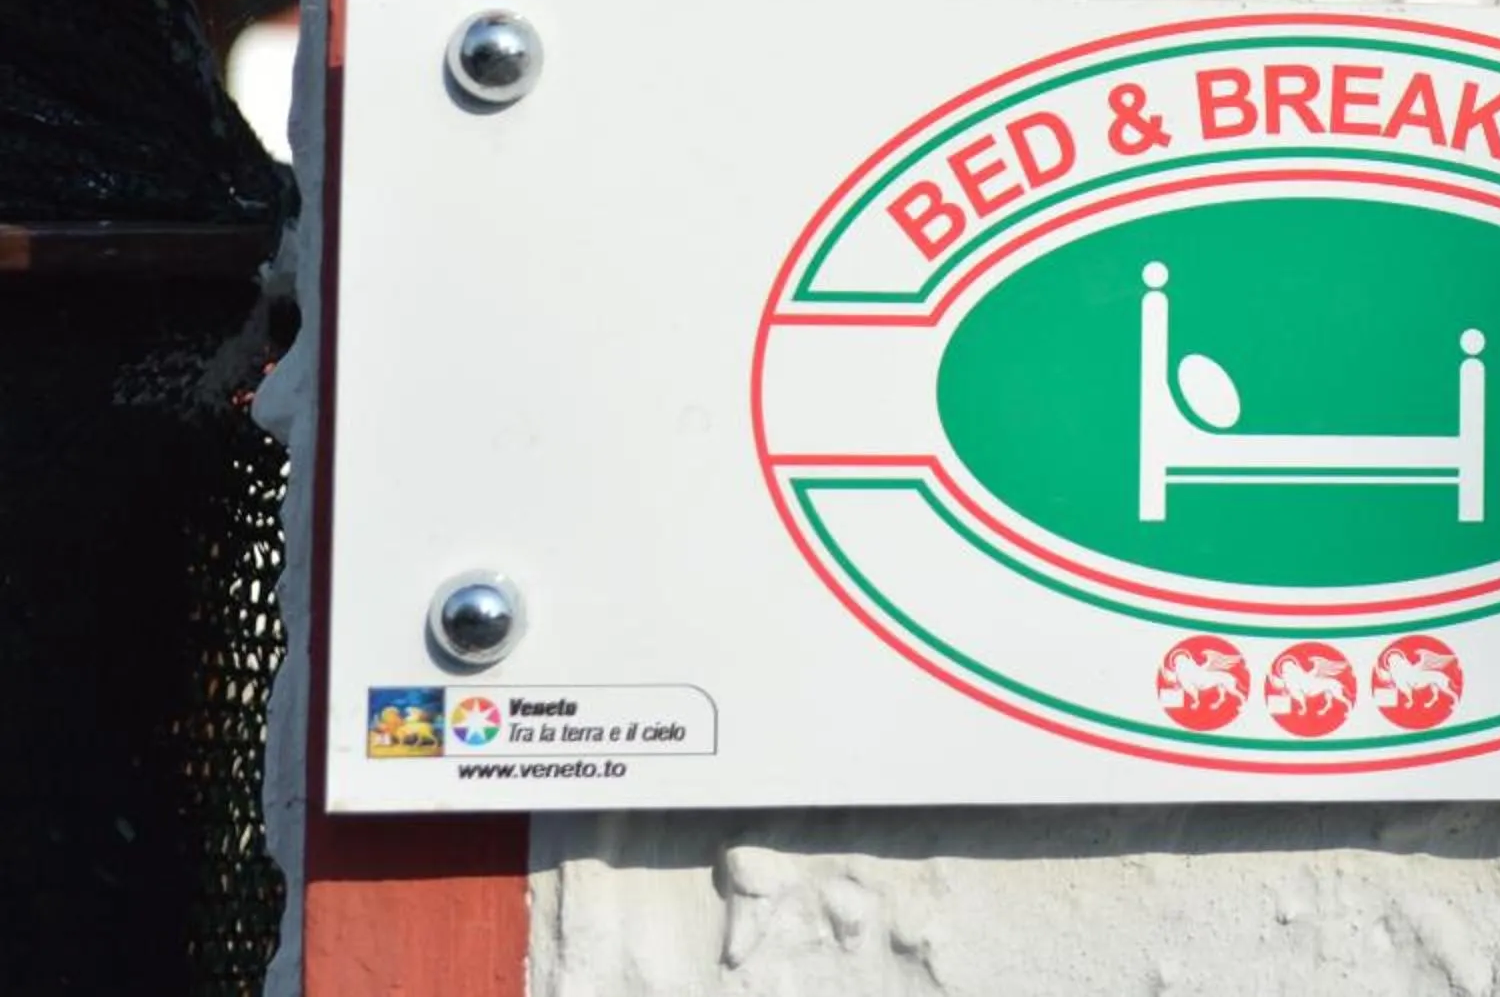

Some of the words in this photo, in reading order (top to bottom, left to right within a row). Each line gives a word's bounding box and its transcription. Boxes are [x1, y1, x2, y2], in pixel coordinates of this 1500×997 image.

[885, 110, 1077, 263] BED
[1106, 82, 1172, 156] &
[508, 698, 578, 717] Veneto
[508, 723, 537, 742] Tra
[539, 723, 556, 742] la
[561, 724, 603, 742] terra
[609, 727, 621, 741] e
[625, 723, 637, 741] il
[641, 722, 686, 741] cielo
[457, 759, 627, 779] www.veneto.to
